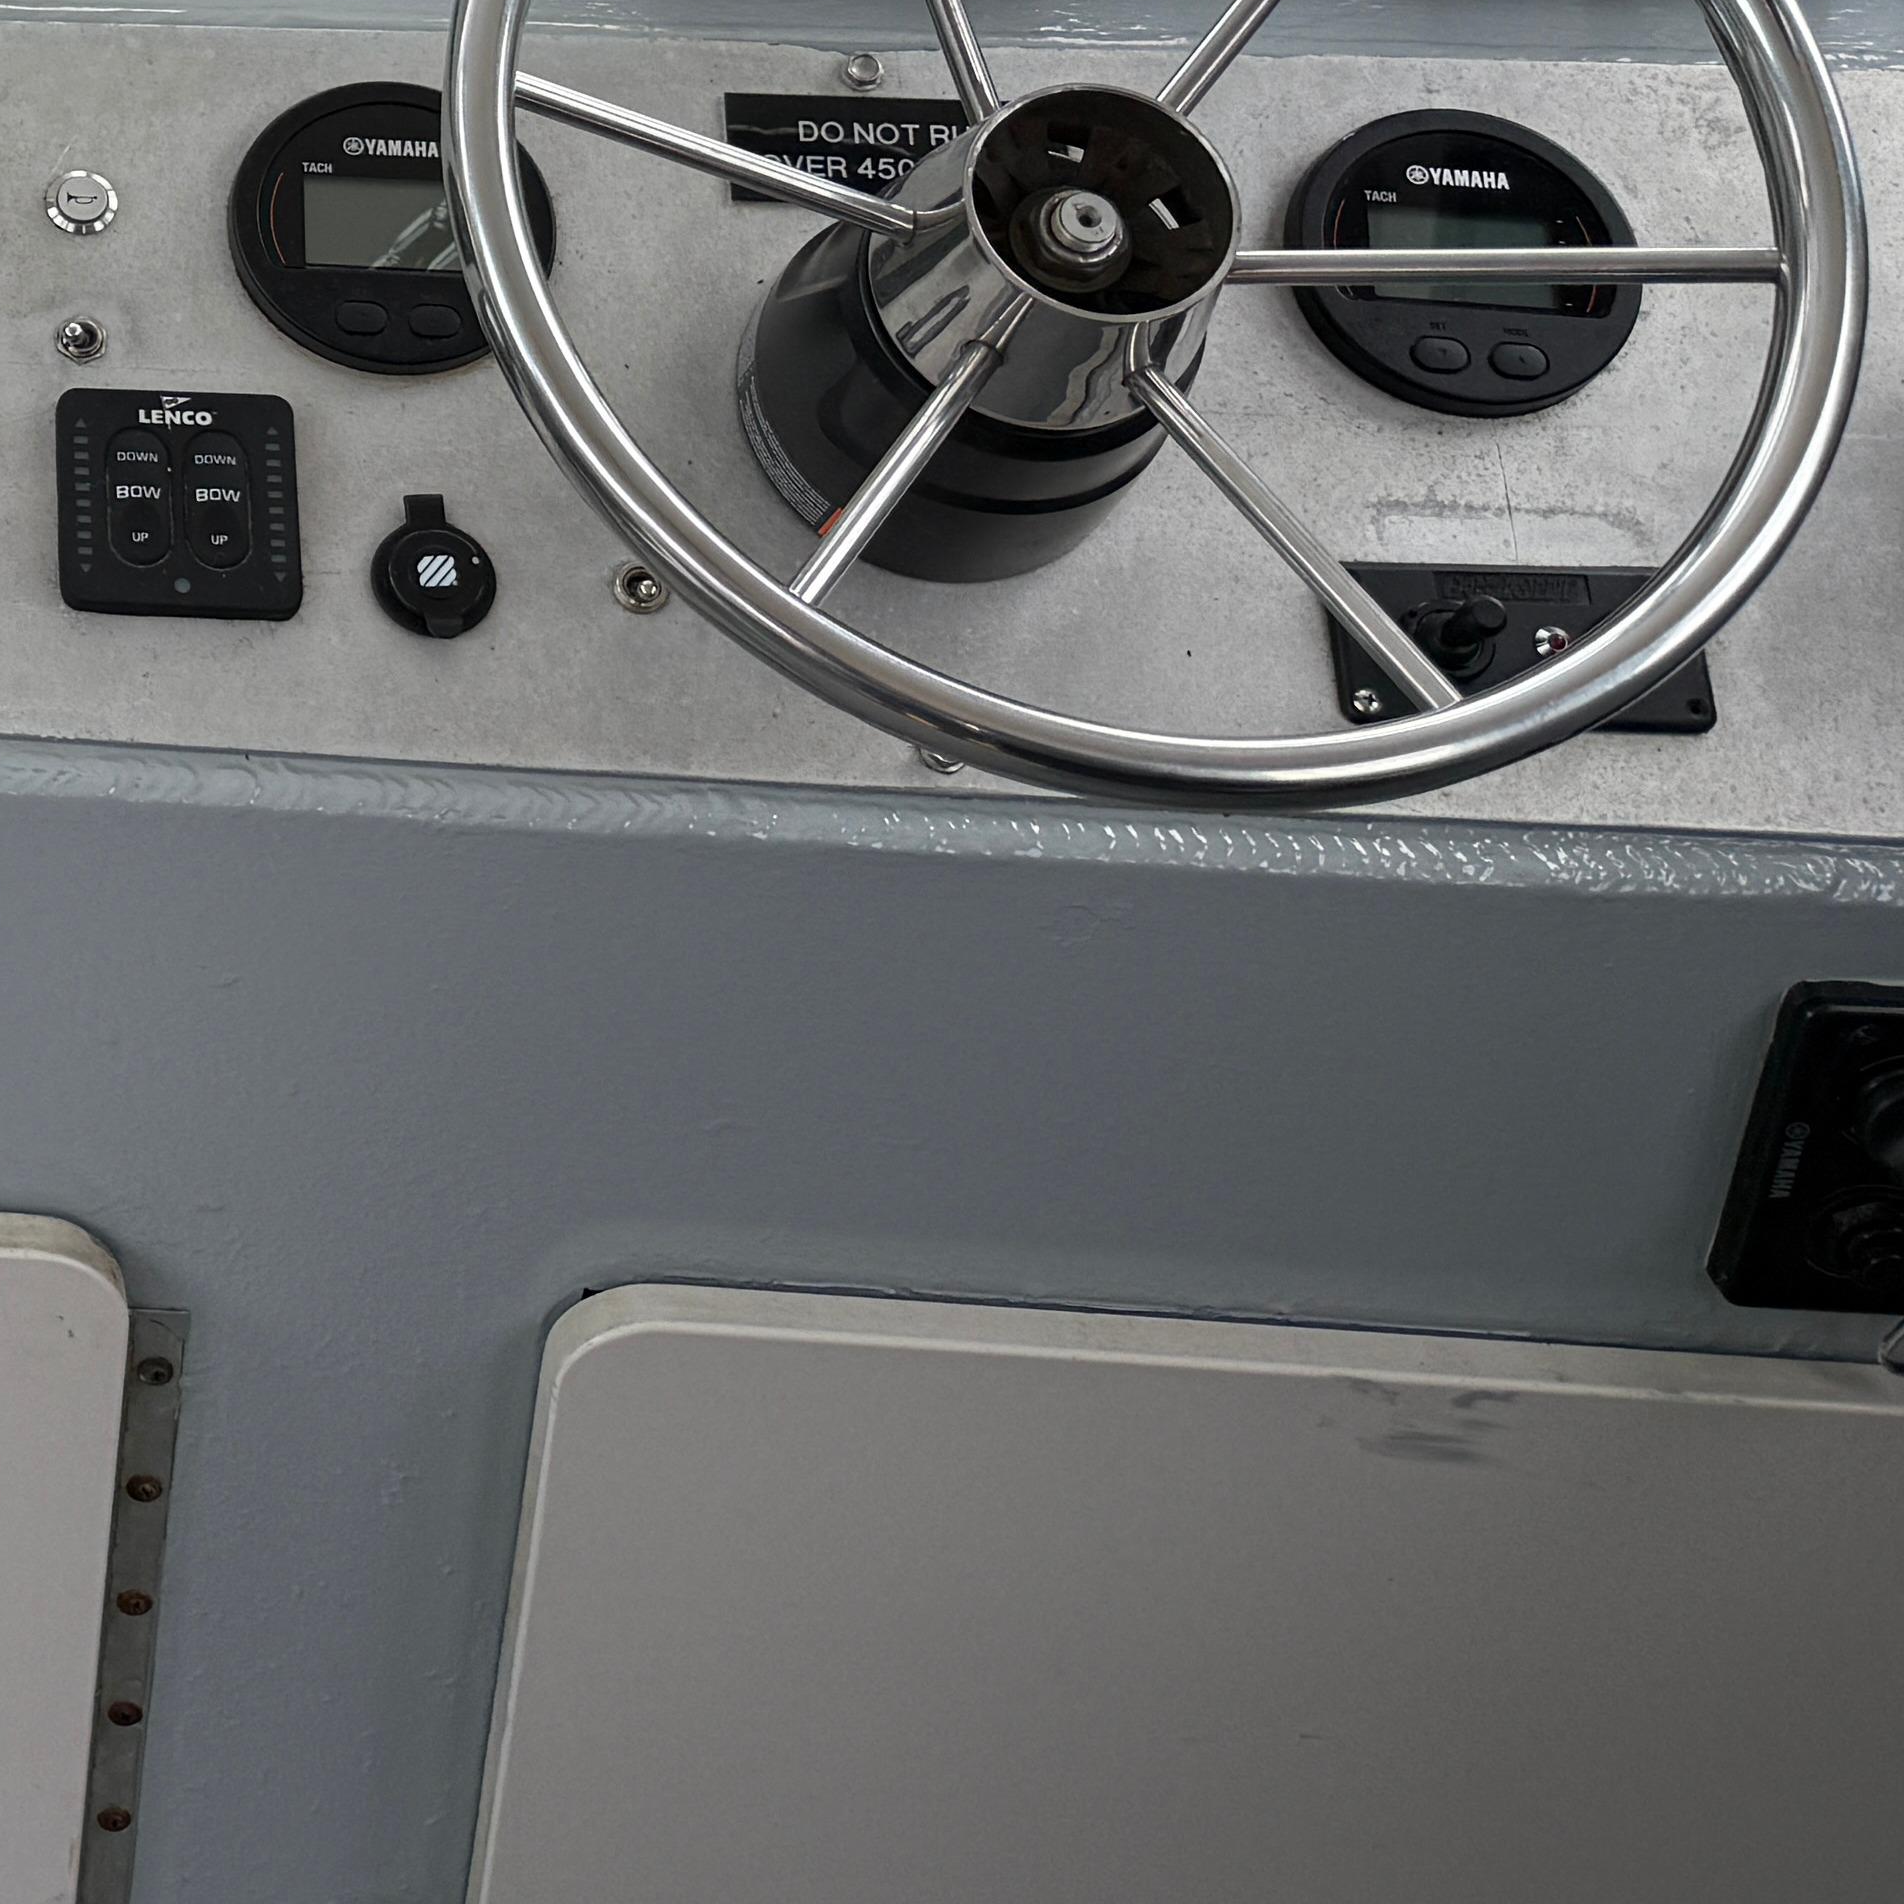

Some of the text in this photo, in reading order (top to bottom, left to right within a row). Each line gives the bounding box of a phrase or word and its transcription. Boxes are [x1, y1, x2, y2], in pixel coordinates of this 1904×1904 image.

[798, 120, 969, 146] DO NOT RU
[364, 138, 439, 158] YAMAHA
[301, 161, 333, 174] TACH
[1428, 167, 1510, 191] YAMAHA
[1363, 189, 1397, 203] TACH
[138, 409, 213, 427] LENCO
[116, 451, 159, 463] DOWN
[194, 454, 237, 466] DOWN
[115, 485, 161, 500] BOW
[195, 488, 241, 503] BOW
[131, 531, 149, 543] UP
[210, 534, 229, 545] UP
[1769, 1140, 1805, 1198] YAMAHA
